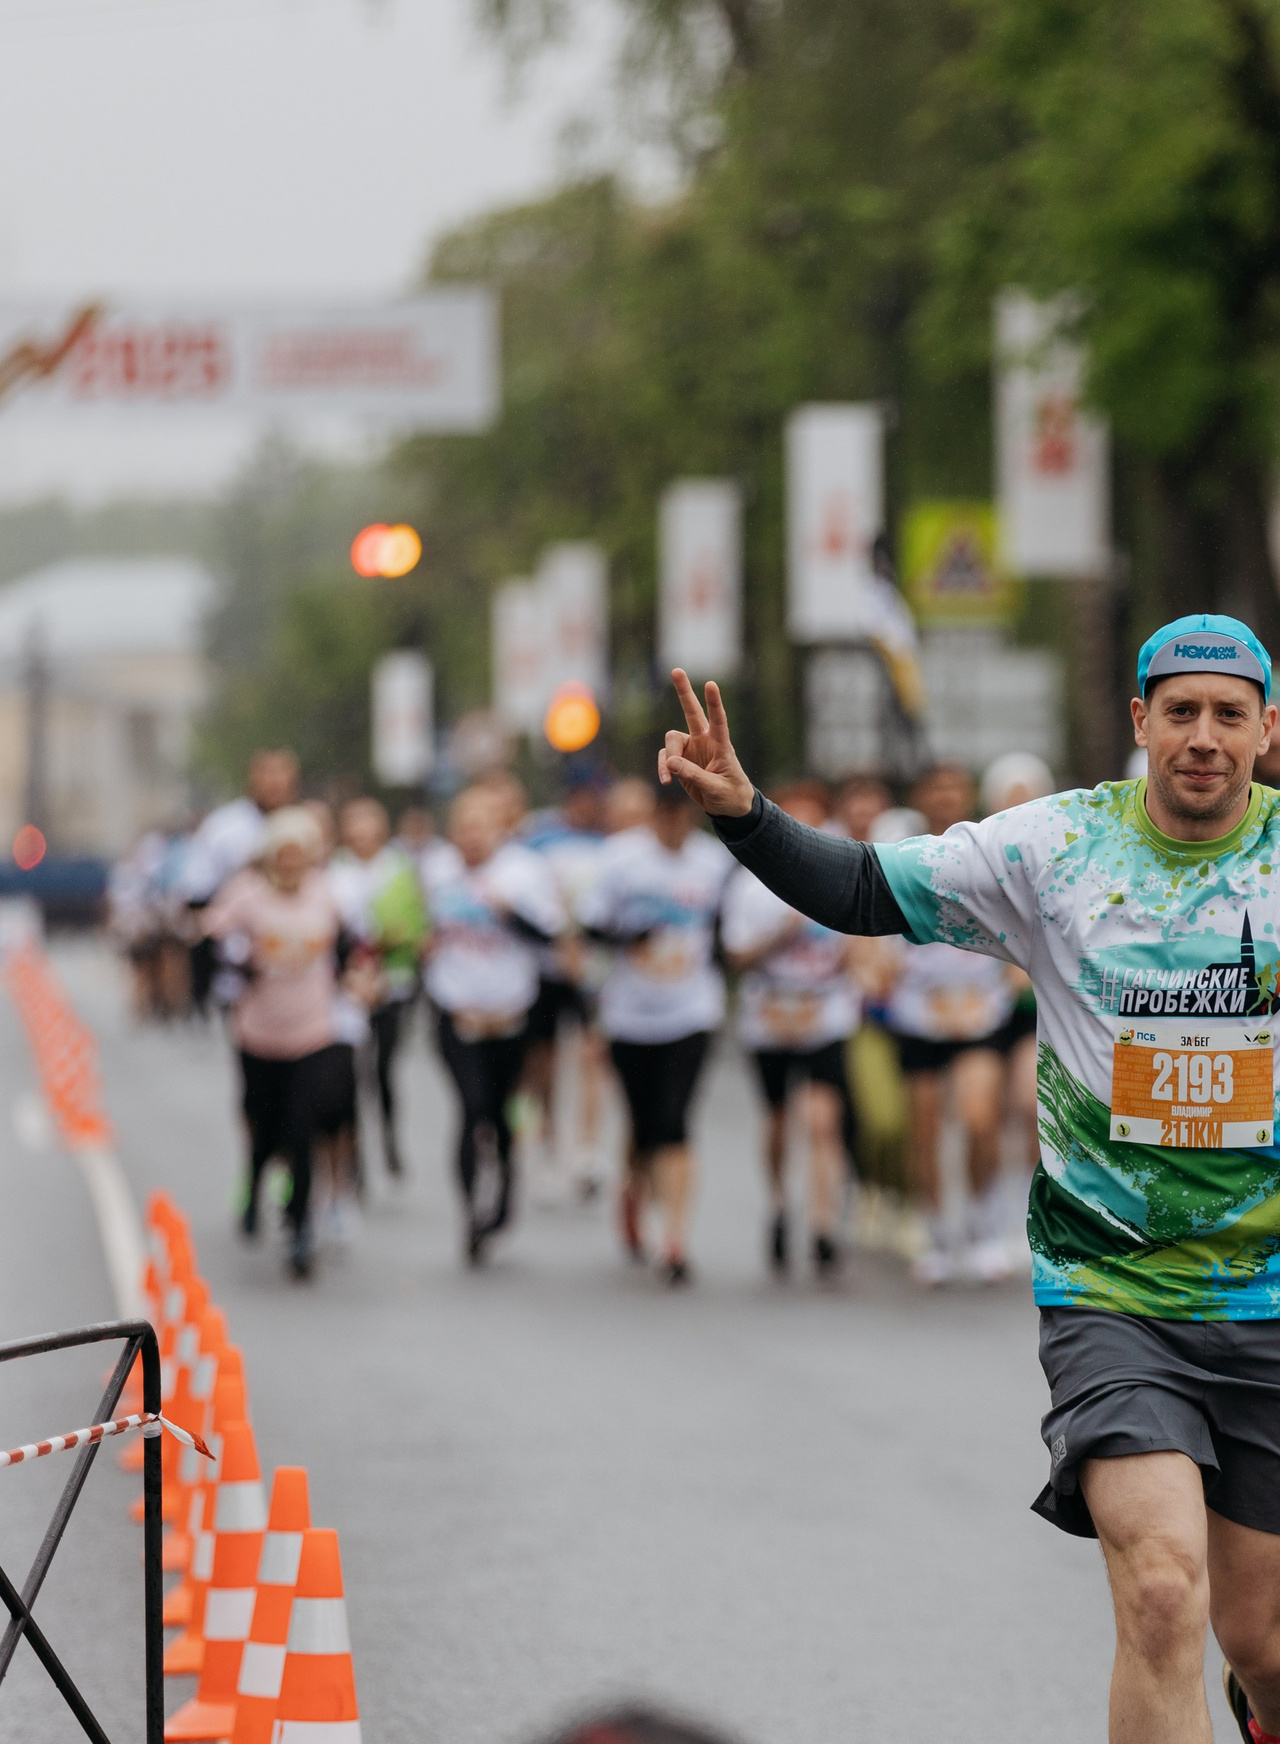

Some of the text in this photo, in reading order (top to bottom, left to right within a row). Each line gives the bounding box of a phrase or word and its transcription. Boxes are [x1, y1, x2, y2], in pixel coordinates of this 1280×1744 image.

[1174, 644, 1219, 660] HOKA
[1219, 652, 1237, 660] ONE
[1119, 990, 1247, 1013] ПРОБЕЖКИ
[1136, 1031, 1156, 1042] ПСБ
[1151, 1051, 1234, 1104] 2193
[1171, 1105, 1213, 1118] ВЛАДИМИР
